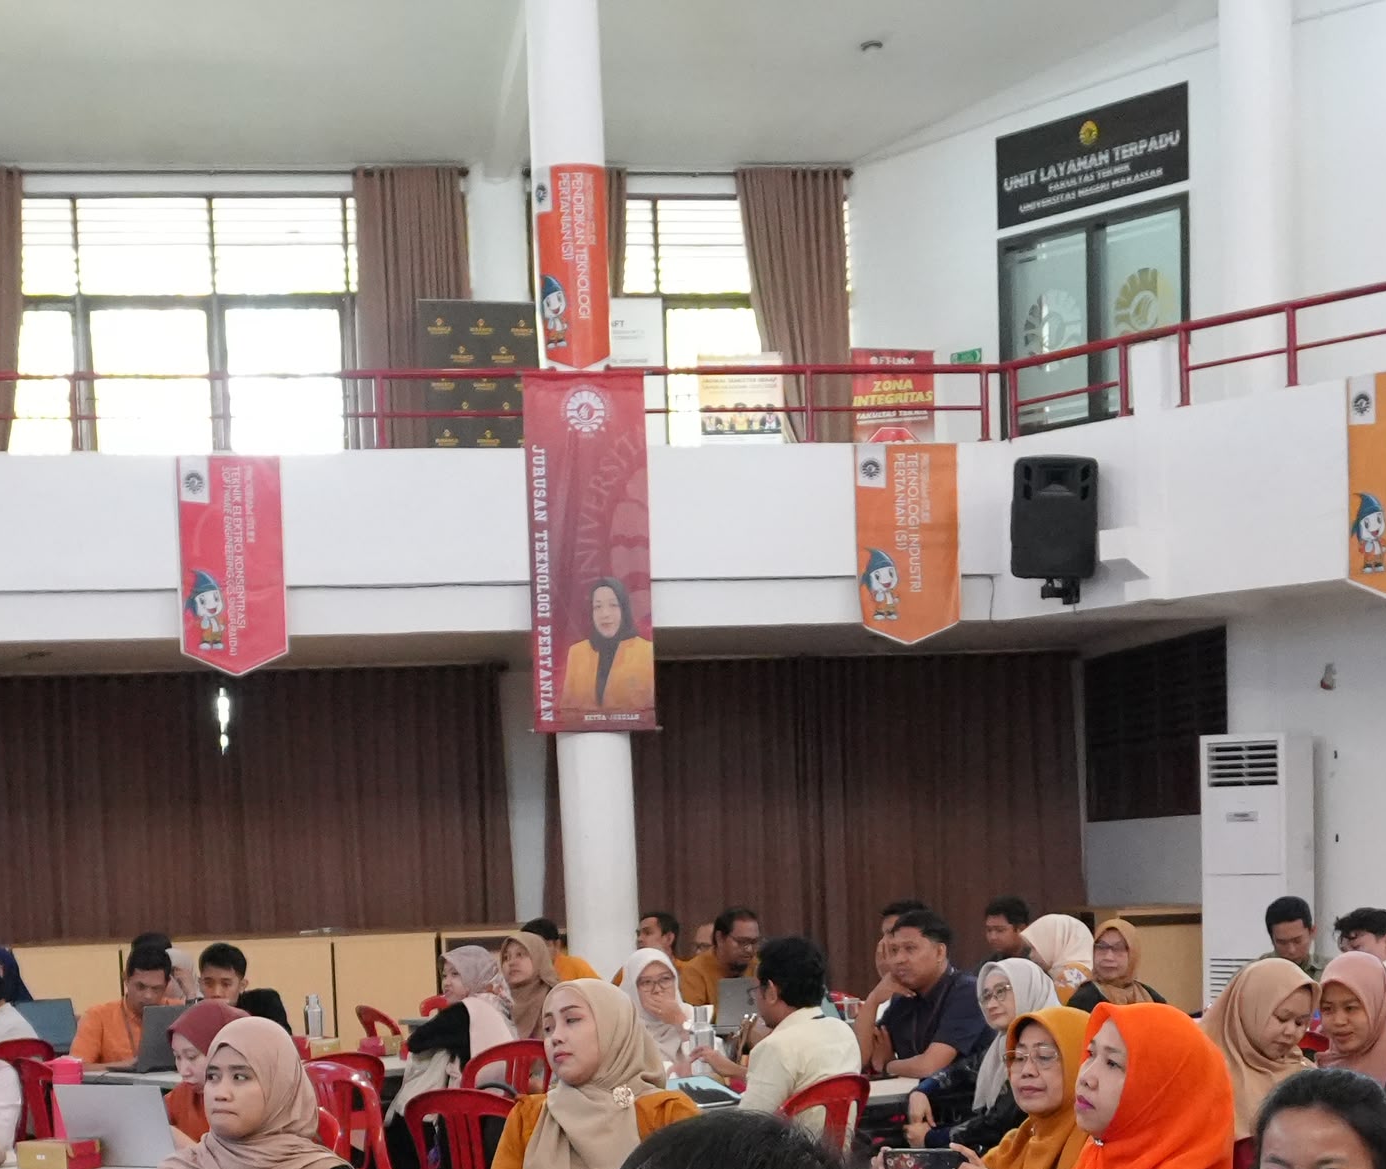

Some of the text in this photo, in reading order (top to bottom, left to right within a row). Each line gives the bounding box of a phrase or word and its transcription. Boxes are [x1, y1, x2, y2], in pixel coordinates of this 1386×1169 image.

[1004, 129, 1181, 192] UNIT LAYANAN TERPADU
[558, 172, 573, 243] PERTANIAN
[572, 172, 591, 320] PENDIDIKAN TEKNOLOGI
[852, 390, 934, 408] INTEGRITAS
[873, 379, 914, 392] ZONA
[894, 453, 906, 526] PERTANIAN
[906, 453, 922, 593] TEKNOLOGI INDUSTRI
[232, 465, 247, 630] TEKNIK ELEKTRO KONSENTRASI
[531, 444, 555, 722] JURUSAN TEKNOLOGI PERTANIAN
